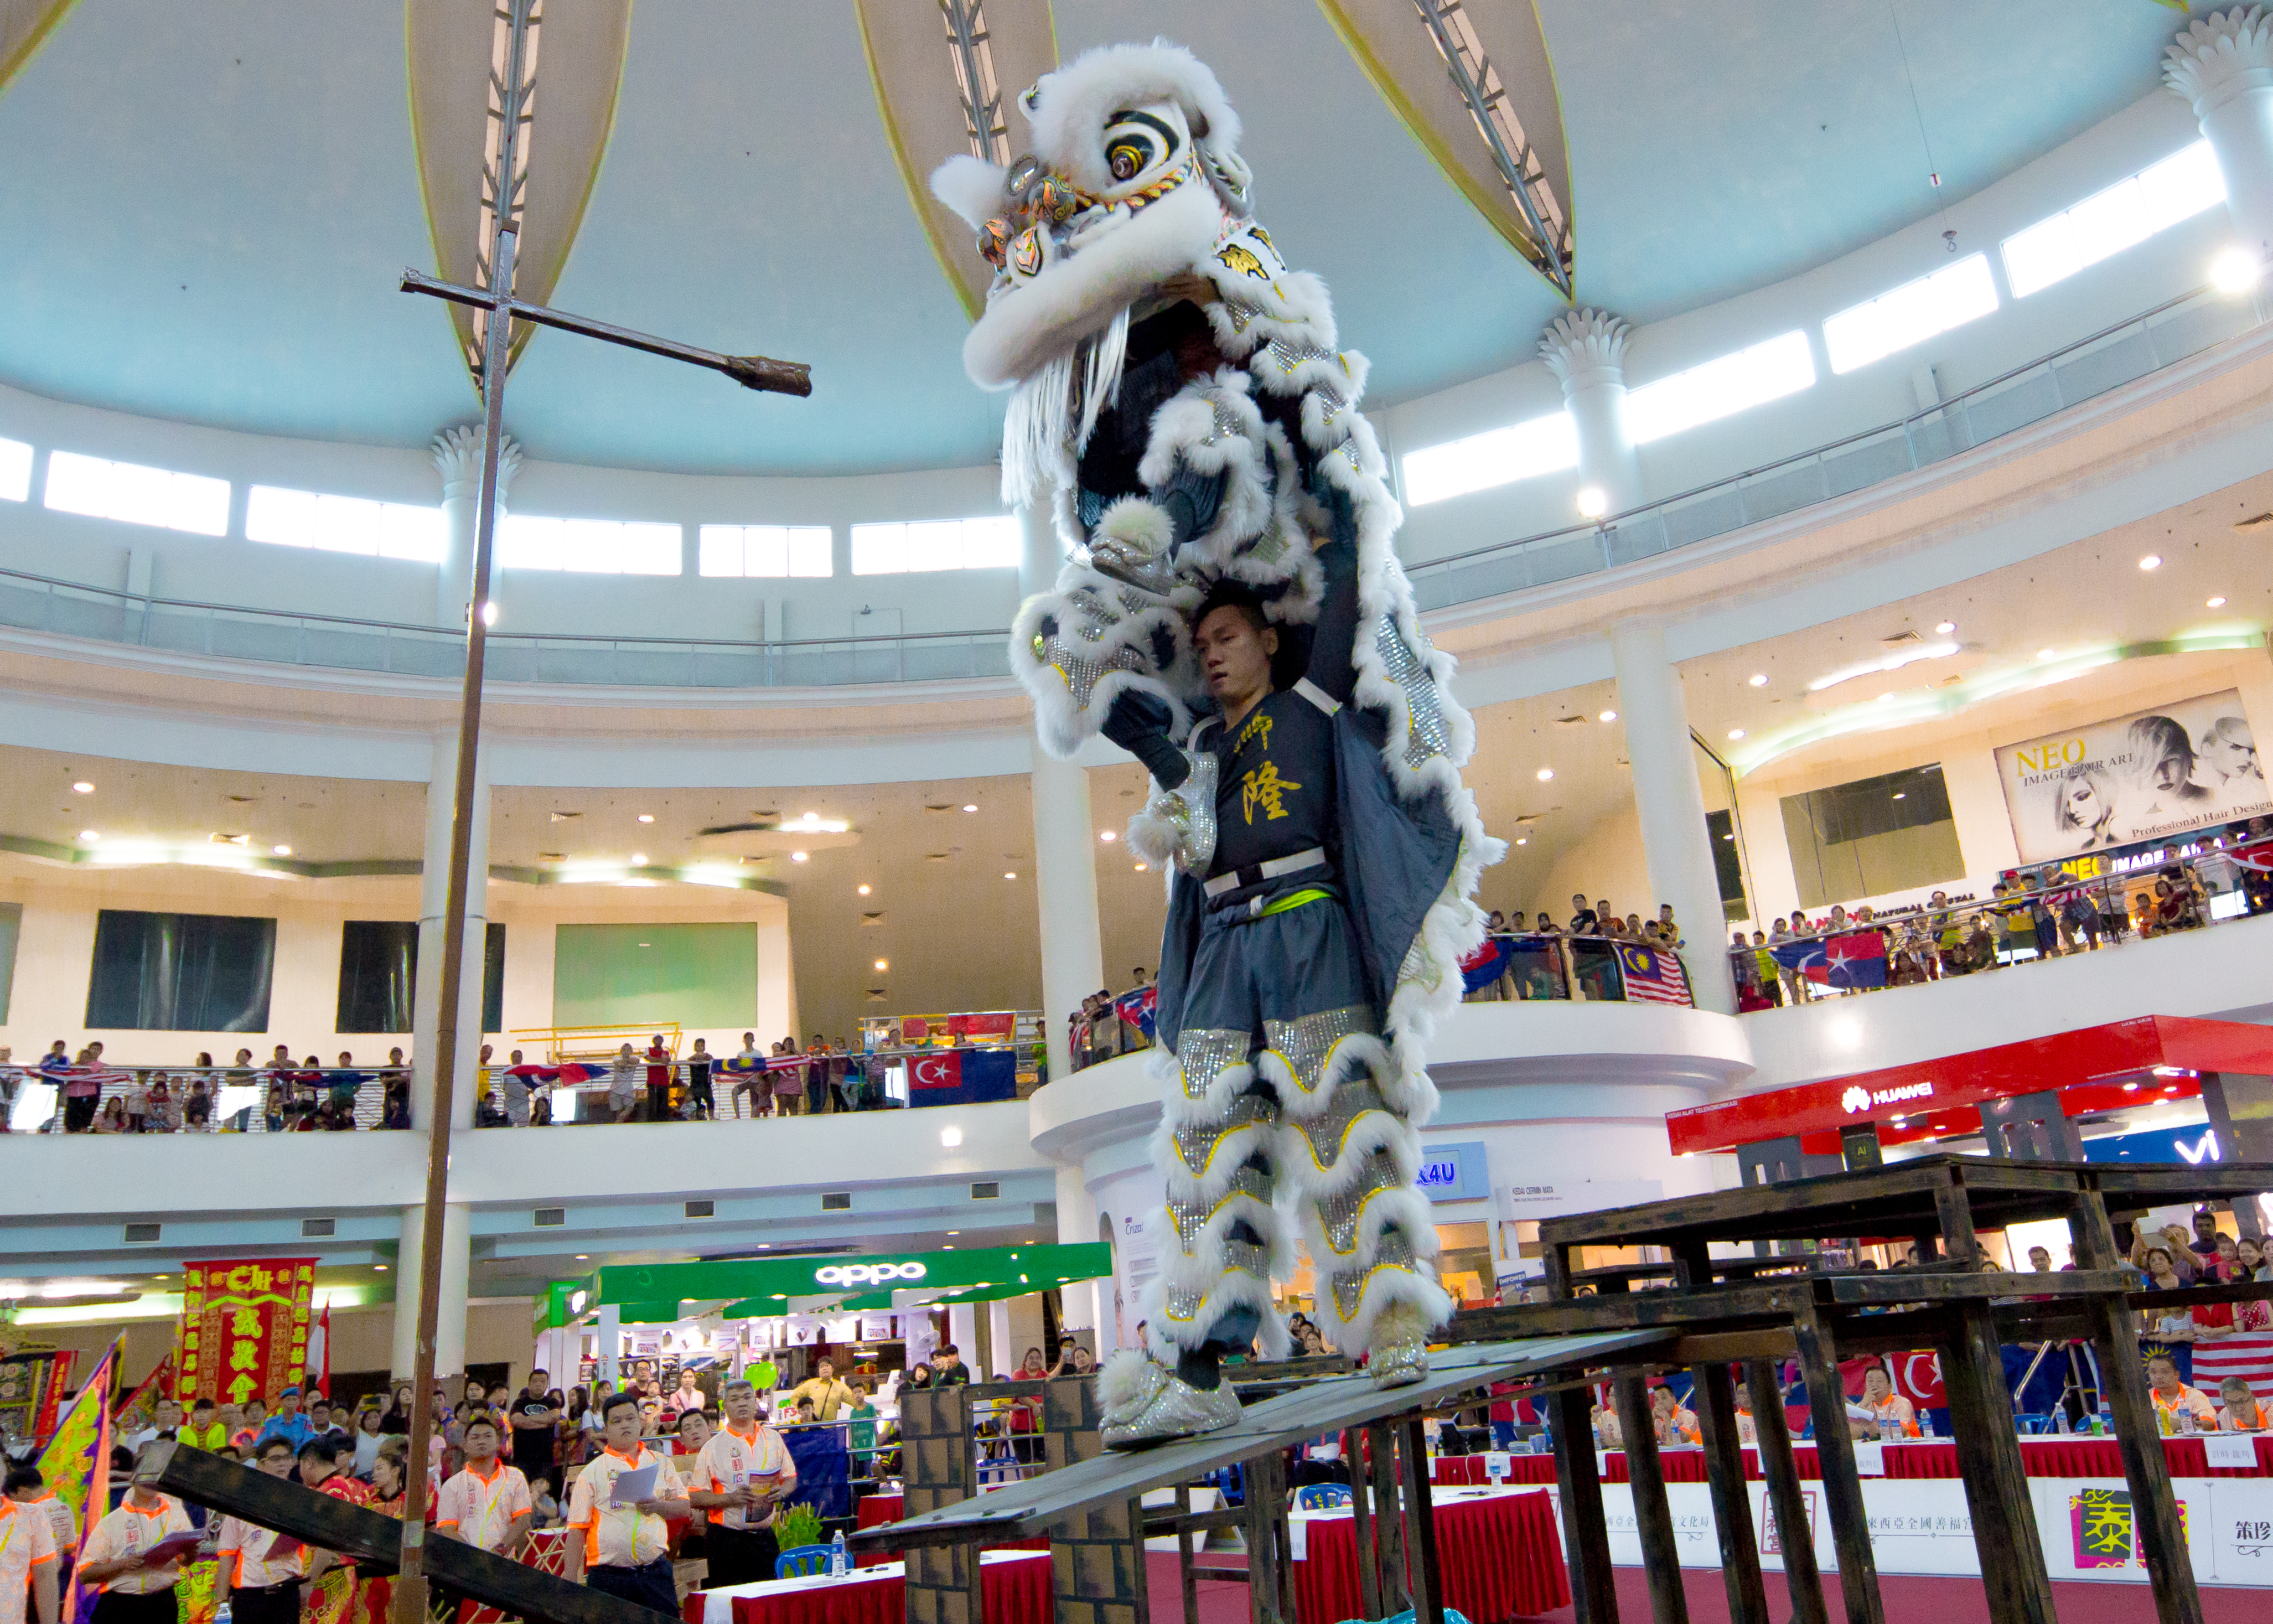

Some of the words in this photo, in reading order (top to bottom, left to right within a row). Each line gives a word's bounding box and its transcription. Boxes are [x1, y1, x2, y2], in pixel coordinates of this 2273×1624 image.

[2015, 738, 2086, 778] NEO
[2023, 768, 2067, 787] IMAGE
[2108, 752, 2135, 767] ART
[2131, 815, 2200, 837] Professional
[2203, 810, 2229, 823] Hair
[2232, 801, 2273, 816] Design
[2111, 850, 2166, 873] IMAGE
[1927, 893, 1975, 909] CSTAL
[1873, 1082, 1933, 1105] HUAWEI
[1542, 1185, 1554, 1194] MATA
[1125, 1222, 1144, 1235] Crizal
[2085, 1500, 2131, 1553] 泰
[2235, 1520, 2271, 1541] 笨珍
